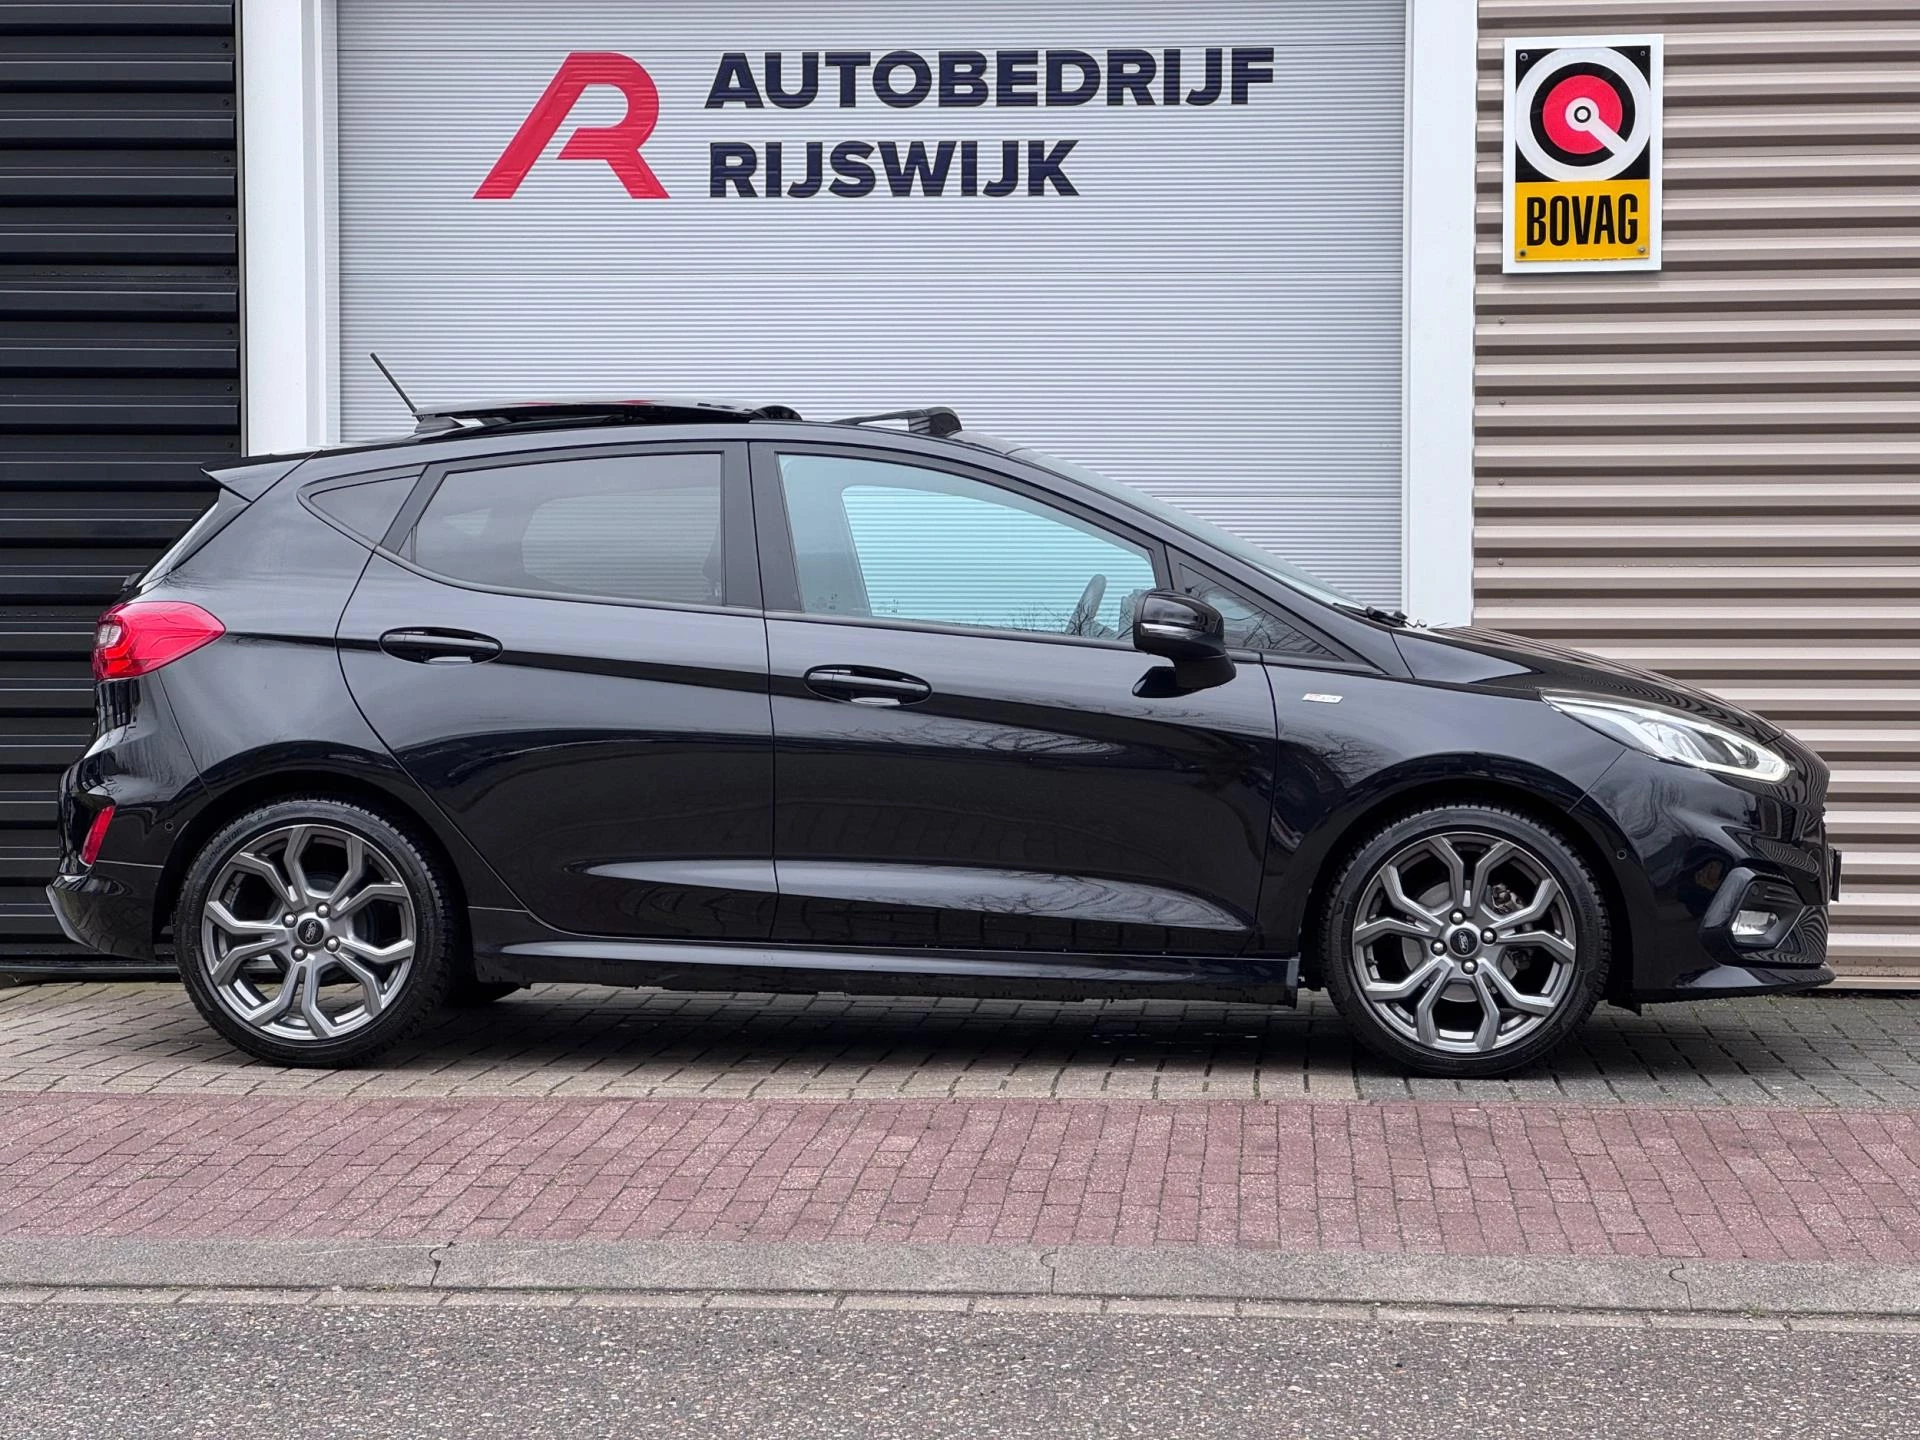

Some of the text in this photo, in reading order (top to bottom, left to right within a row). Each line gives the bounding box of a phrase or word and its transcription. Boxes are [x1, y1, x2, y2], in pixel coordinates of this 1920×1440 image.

[705, 48, 1275, 109] AUTOBEDRIJF
[709, 140, 1079, 199] RIJSWIJK
[1526, 194, 1639, 247] BOVAG
